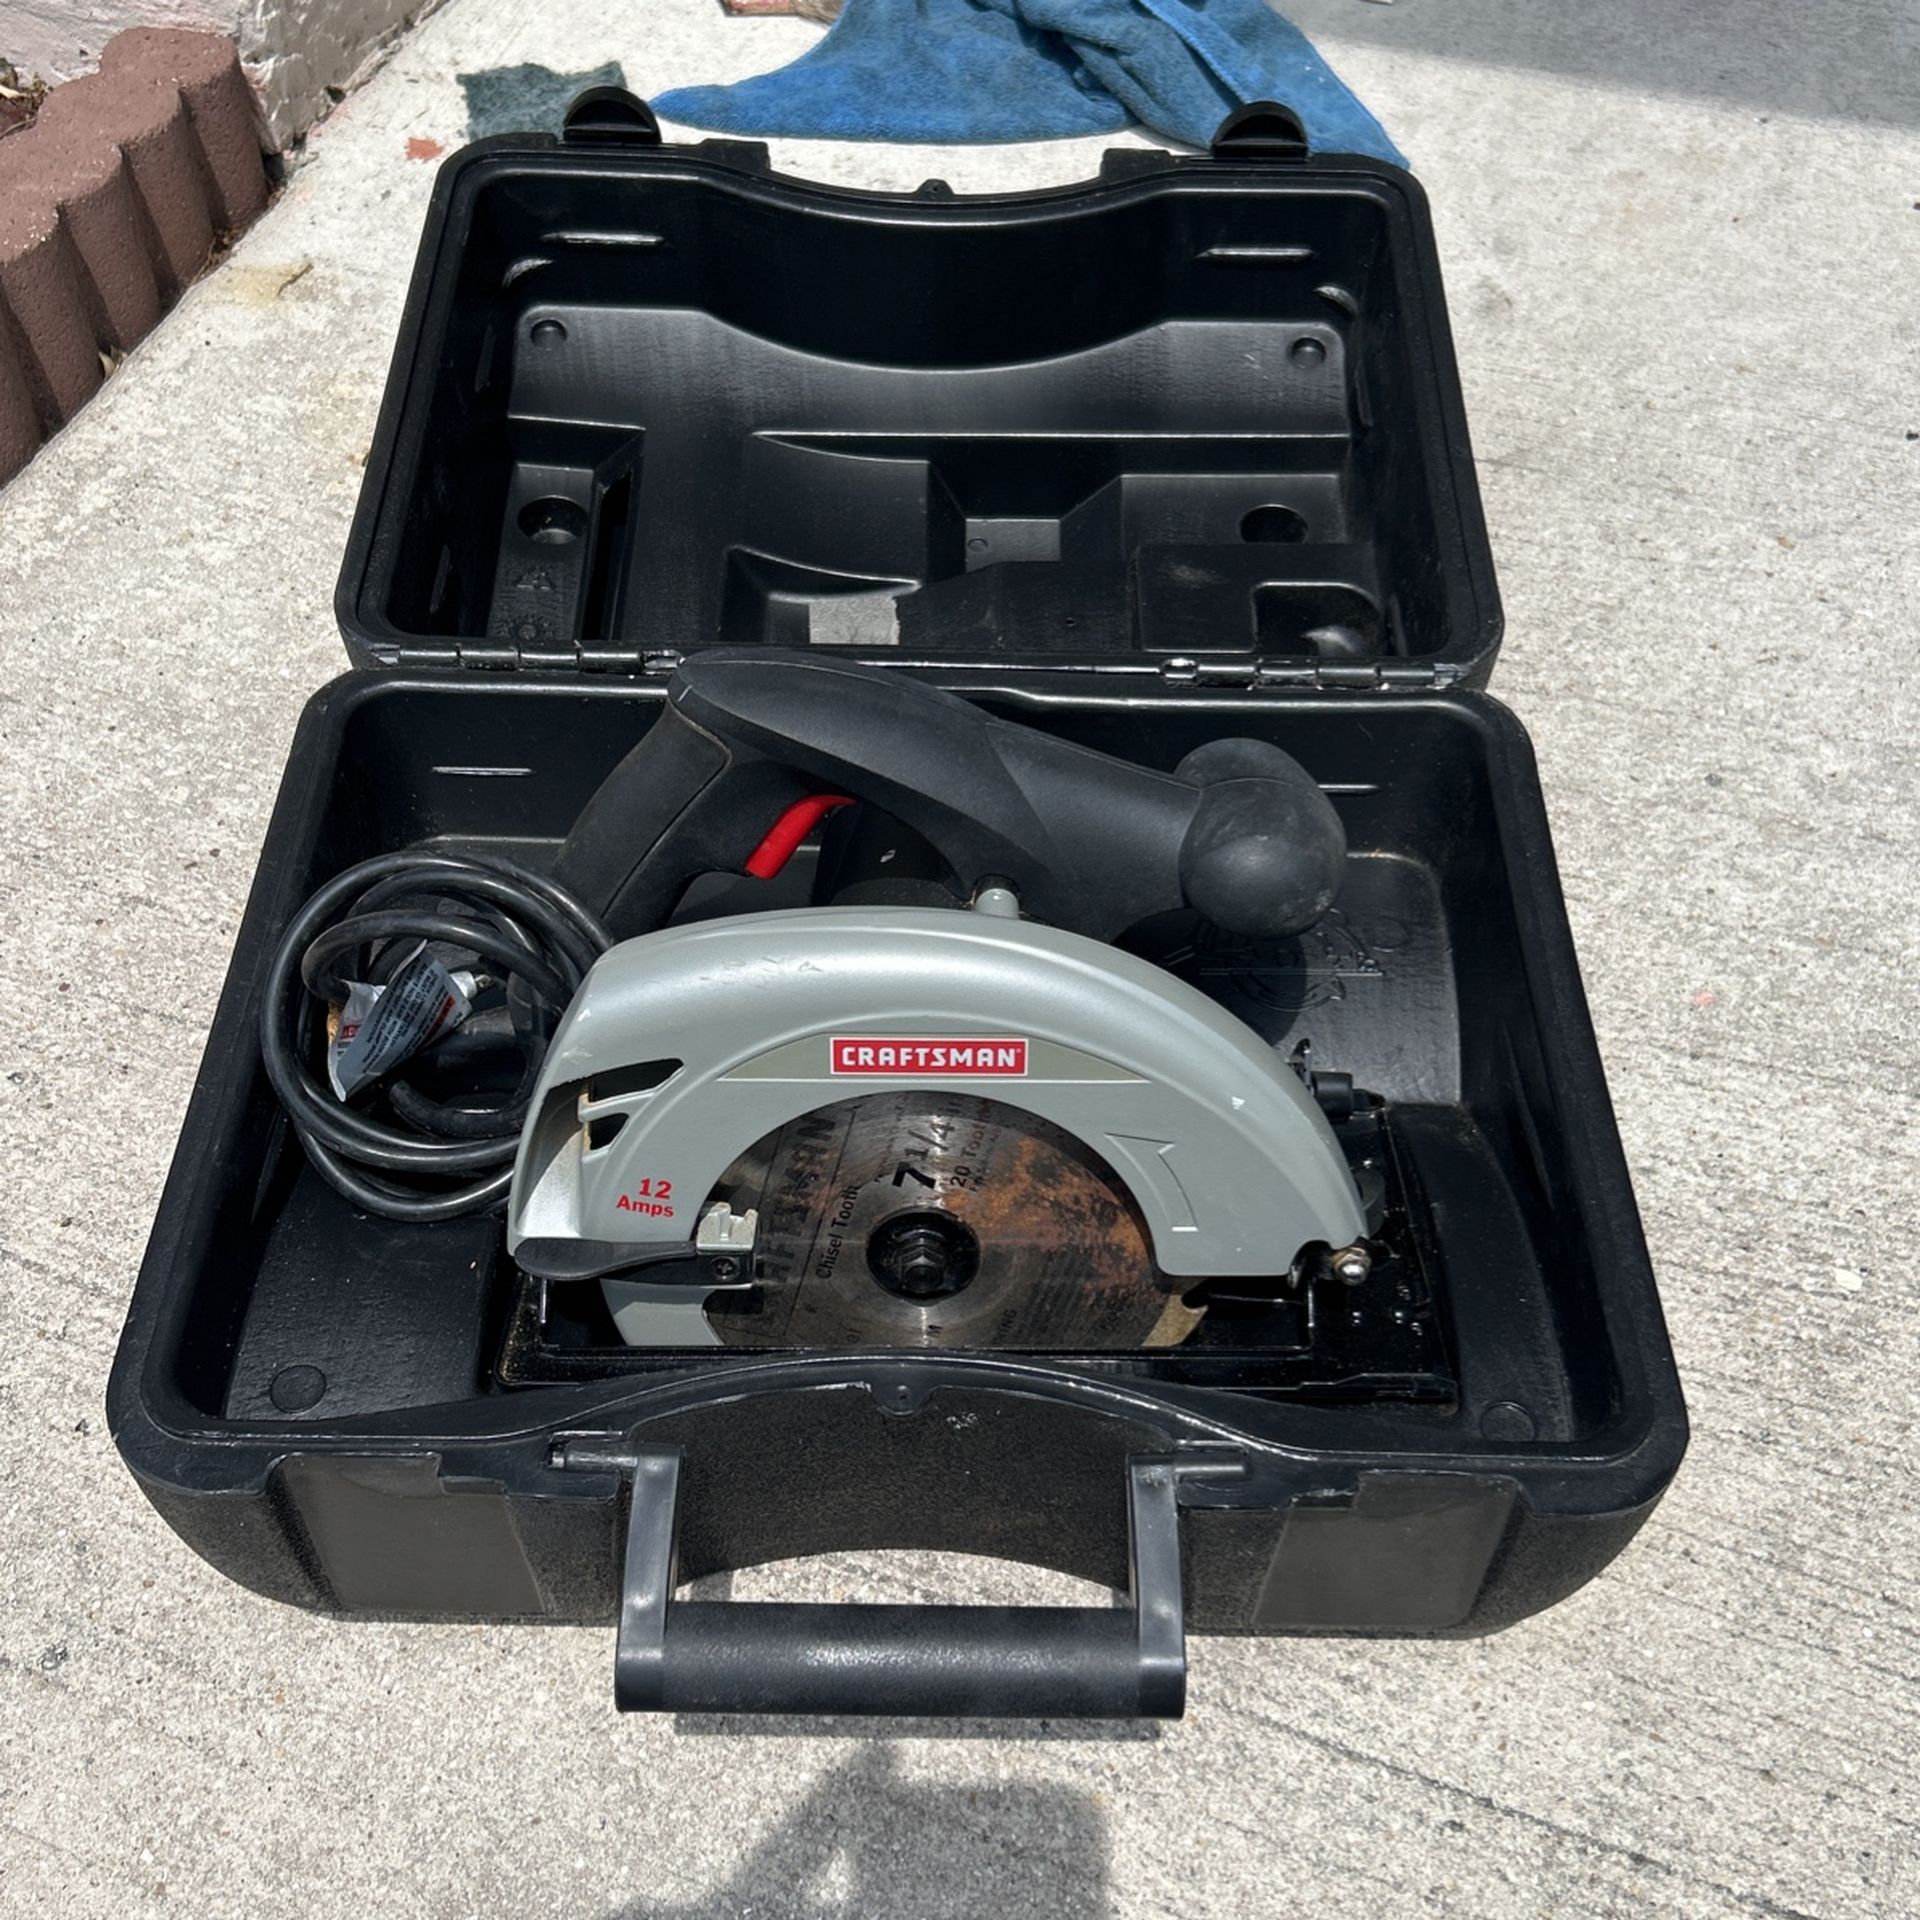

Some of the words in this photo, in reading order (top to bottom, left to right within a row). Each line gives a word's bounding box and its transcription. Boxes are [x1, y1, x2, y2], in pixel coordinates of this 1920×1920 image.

[841, 1046, 1016, 1068] CRAFTSMAN
[950, 1164, 971, 1188] 20
[638, 1177, 673, 1200] 12
[615, 1193, 675, 1218] Amps
[815, 1232, 842, 1280] Chisel
